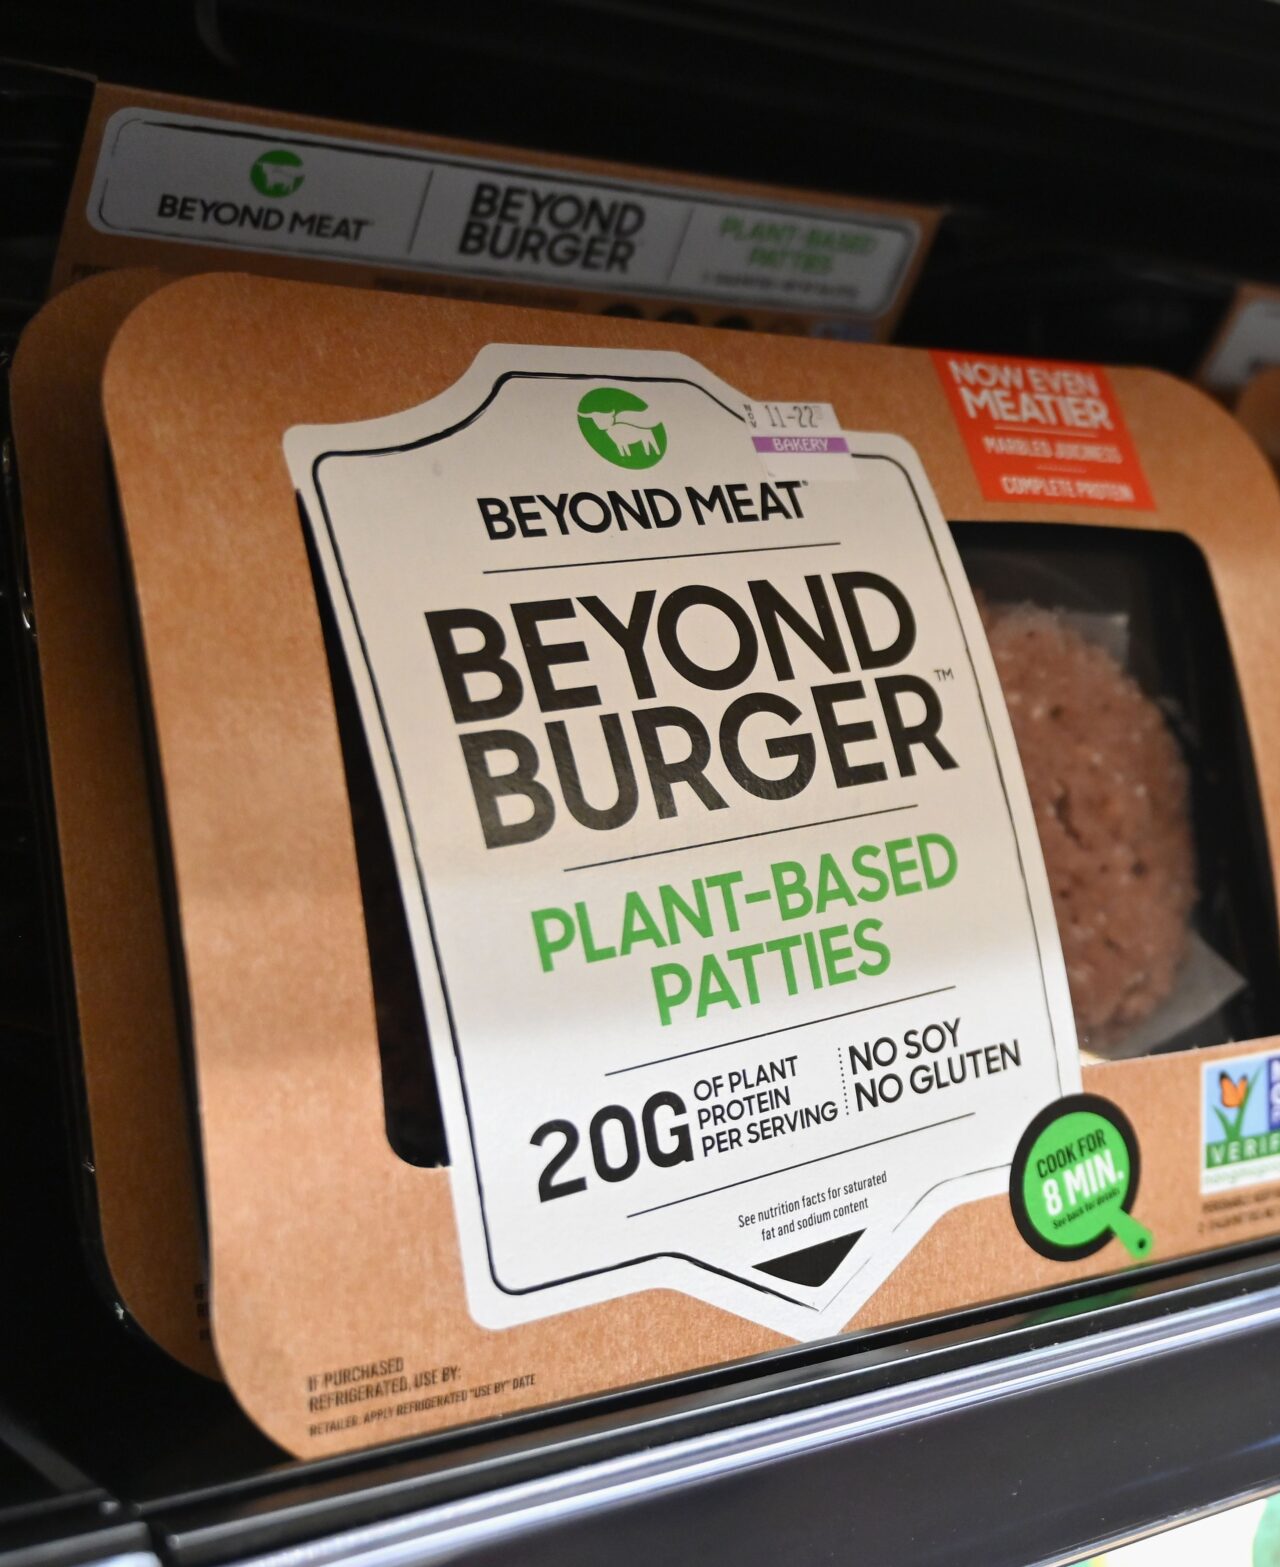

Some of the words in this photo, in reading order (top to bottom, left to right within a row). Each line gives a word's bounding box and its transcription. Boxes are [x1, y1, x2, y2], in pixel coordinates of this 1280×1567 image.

[157, 195, 284, 232] BEYOND
[291, 209, 368, 241] MEAT
[471, 183, 645, 237] BEYOND
[459, 222, 634, 273] BURGER
[949, 360, 1023, 389] NOW
[1026, 368, 1099, 396] EVEN
[960, 388, 1114, 430] MEATIER
[772, 438, 828, 451] BAKERY
[476, 487, 683, 540] BEYOND
[692, 481, 806, 526] MEAT
[424, 571, 917, 724] BEYOND
[459, 674, 959, 849] BURGER
[531, 833, 958, 972] PLANT-BASED
[651, 918, 891, 1026] PATTIES
[849, 1037, 897, 1075] NO
[904, 1018, 961, 1058] SOY
[694, 1076, 724, 1100] OF
[729, 1055, 798, 1092] PLANT
[855, 1074, 903, 1111] NO
[910, 1039, 1021, 1094] GLUTEN
[698, 1086, 791, 1129] PROTEIN
[702, 1128, 742, 1157] PER
[748, 1101, 838, 1143] SERVING
[529, 1090, 694, 1202] 20G
[1037, 1143, 1076, 1178] COOK
[1077, 1129, 1106, 1157] FOR
[738, 1214, 756, 1228] See
[758, 1198, 800, 1222] nutrition
[802, 1191, 826, 1208] facts
[828, 1187, 841, 1200] for
[843, 1171, 887, 1196] saturated
[1043, 1179, 1063, 1216] 8
[1063, 1149, 1124, 1206] MIN.
[762, 1228, 775, 1241] fat
[778, 1220, 795, 1237] and
[797, 1211, 831, 1229] sodium
[833, 1197, 868, 1218] content
[308, 1377, 320, 1392] IF
[324, 1357, 404, 1387] PURCHASED
[363, 1409, 393, 1424] APPLY
[396, 1390, 467, 1415] REFRIGERATED
[512, 1374, 535, 1389] DATE
[414, 1371, 438, 1388] USE
[441, 1366, 461, 1382] BY:
